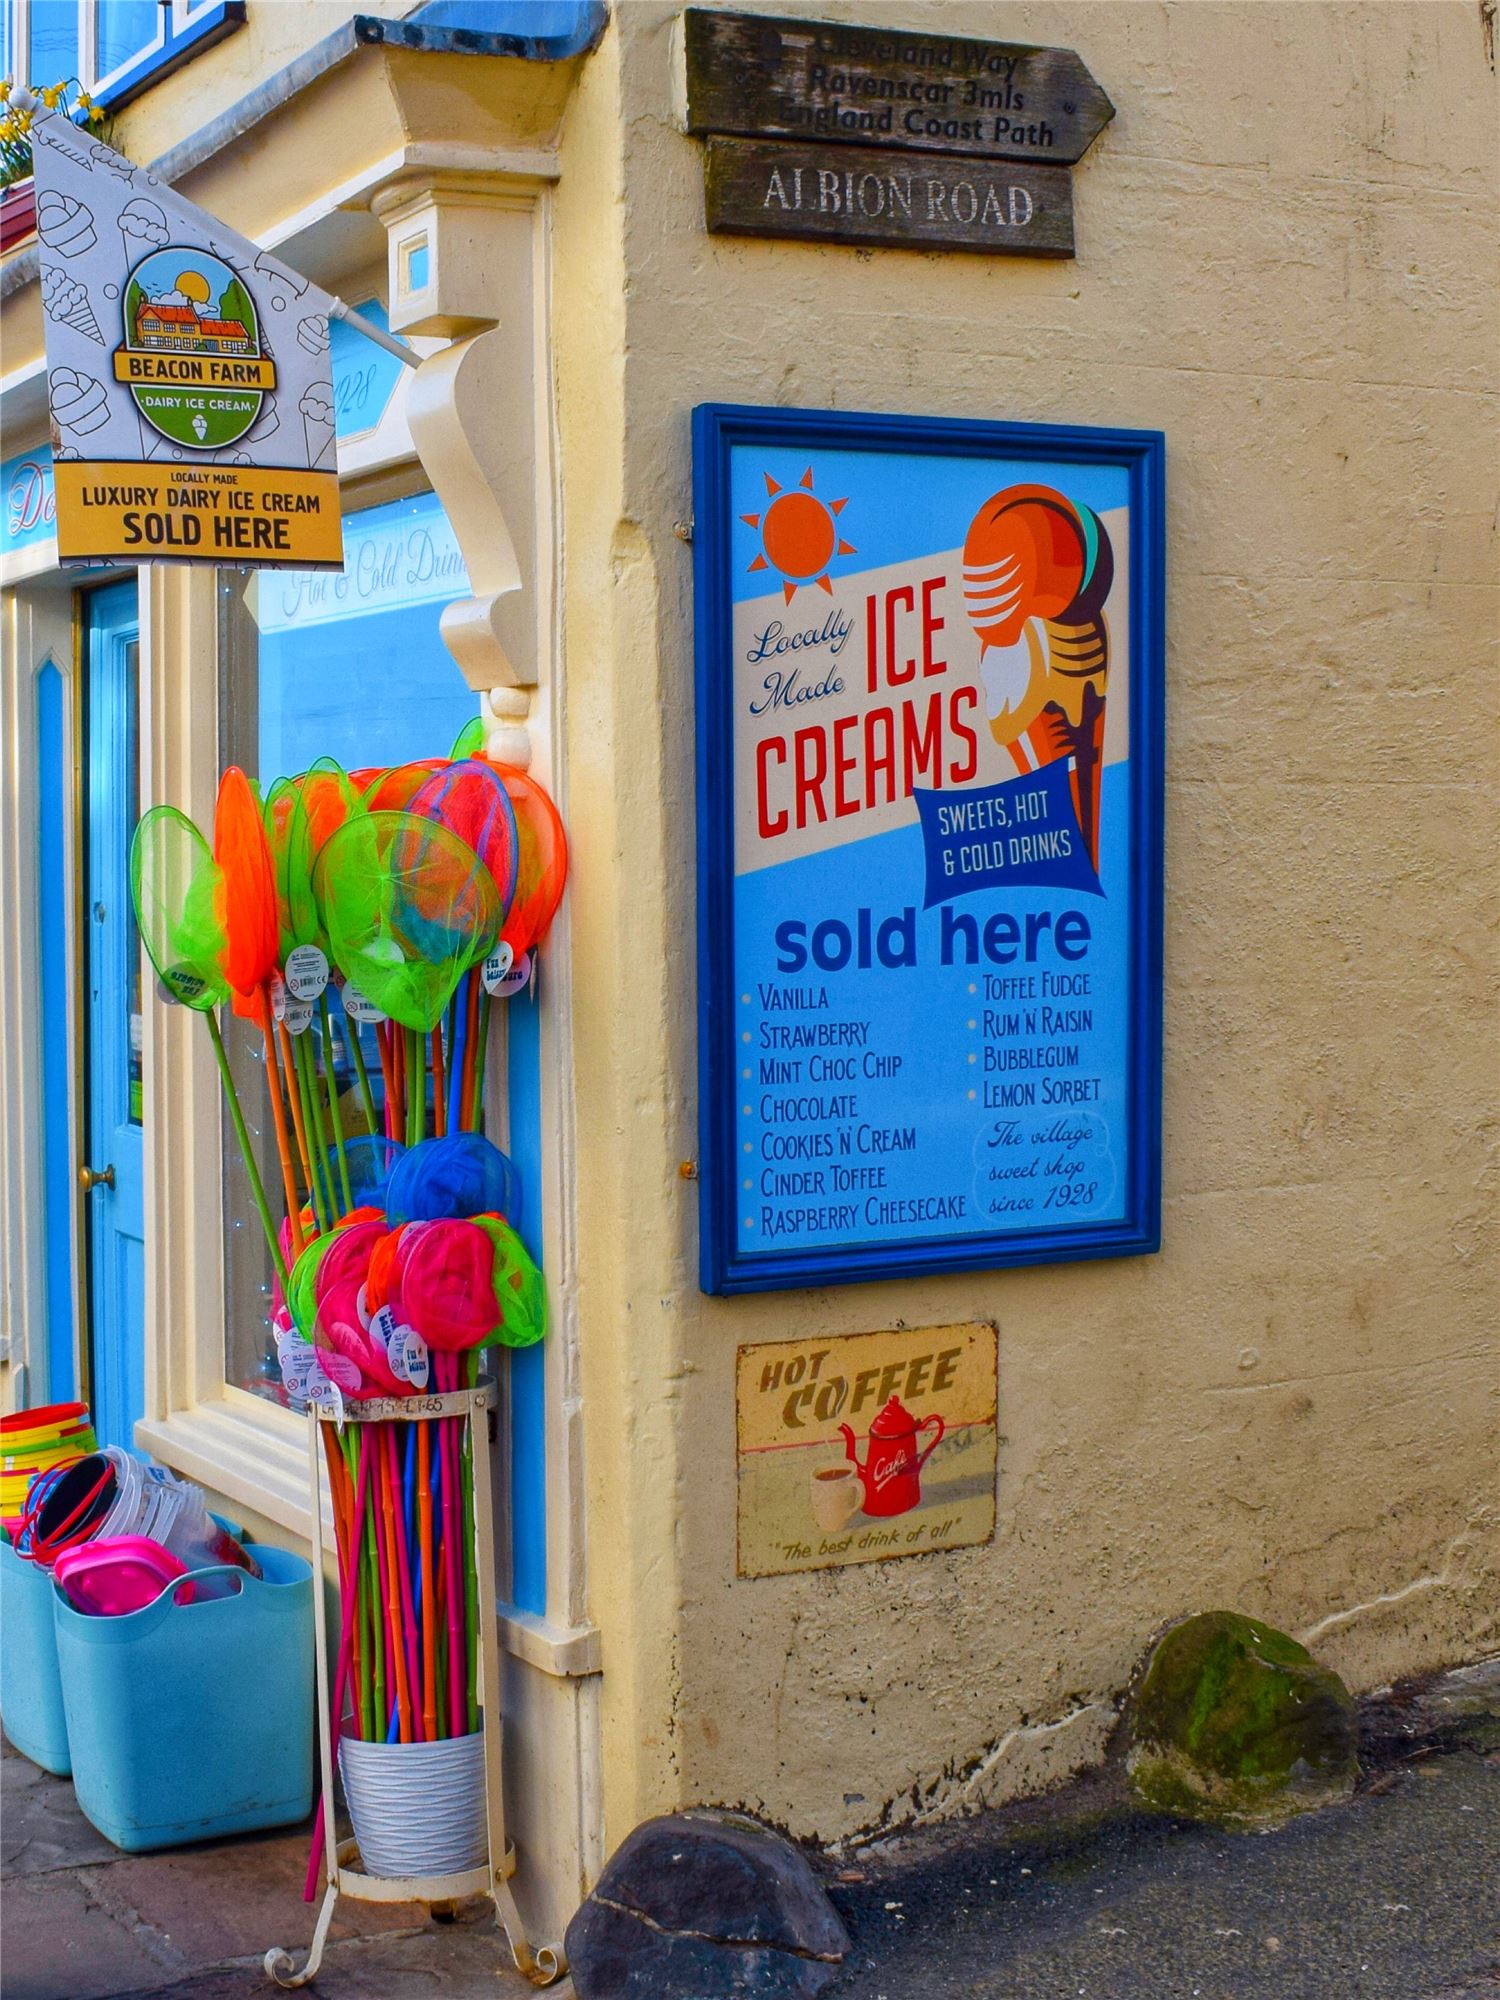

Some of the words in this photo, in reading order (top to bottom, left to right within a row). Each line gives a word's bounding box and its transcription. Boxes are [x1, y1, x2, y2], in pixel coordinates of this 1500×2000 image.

[815, 31, 952, 68] Cleveland
[963, 48, 1019, 82] Way
[809, 64, 954, 103] Ravenscar
[963, 82, 1023, 111] 3mls
[779, 97, 892, 131] England
[904, 109, 983, 140] Coast
[994, 115, 1053, 147] Path
[763, 165, 911, 219] ALBION
[927, 181, 1033, 227] ROAD
[130, 358, 203, 381] BEACON
[211, 362, 261, 384] FARM
[145, 396, 181, 409] DAIRY
[186, 399, 205, 409] ICE
[210, 399, 251, 411] CREAM
[171, 472, 209, 483] LOCALLY
[213, 474, 238, 485] MADE
[82, 487, 160, 506] LUXURY
[168, 488, 220, 509] DAIRY
[229, 492, 253, 510] ICE
[262, 493, 320, 513] CREAM
[123, 512, 200, 546] SOLD
[215, 515, 291, 550] HERE
[357, 540, 402, 597] Cold
[747, 609, 854, 662] Locally
[866, 575, 947, 694] ICE
[750, 666, 845, 716] Made
[756, 685, 978, 839] CREAMS
[938, 797, 1013, 836] SWEETS,
[1016, 790, 1048, 823] HOT
[943, 850, 956, 876] &
[960, 840, 1004, 874] COLD
[1010, 830, 1071, 865] DRINKS
[775, 907, 917, 973] sold
[940, 906, 1092, 966] here
[758, 983, 829, 1011] VANILLA
[983, 974, 1036, 1000] TOFFEE
[1042, 971, 1092, 997] FUDGE
[759, 1022, 871, 1051] STRAWBERRY
[983, 1009, 1019, 1039] RUM
[1042, 1006, 1093, 1035] RAISIN
[759, 1058, 802, 1085] MINT
[809, 1055, 857, 1083] CHOC
[863, 1052, 902, 1079] CHIP
[984, 1046, 1079, 1072] BUBBLEGUM
[760, 1095, 858, 1124] CHOCOLATE
[983, 1080, 1036, 1109] LEMON
[1042, 1077, 1101, 1103] SORBET
[761, 1132, 833, 1162] COOKIES
[857, 1124, 916, 1152] CREAM
[987, 1120, 1024, 1148] The
[1031, 1118, 1093, 1150] village
[760, 1168, 824, 1197] CINDER
[830, 1164, 887, 1192] TOFFEE
[989, 1163, 1037, 1182] sweet
[1044, 1156, 1085, 1185] shop
[989, 1196, 1035, 1216] since
[1044, 1181, 1099, 1210] 1928
[760, 1204, 859, 1240] RASPBERRY
[864, 1195, 967, 1227] CHEESECAKE
[759, 1350, 831, 1393] HOT
[782, 1346, 962, 1429] COFFEE
[818, 1537, 852, 1555] best
[858, 1531, 900, 1550] drink
[906, 1525, 923, 1543] of
